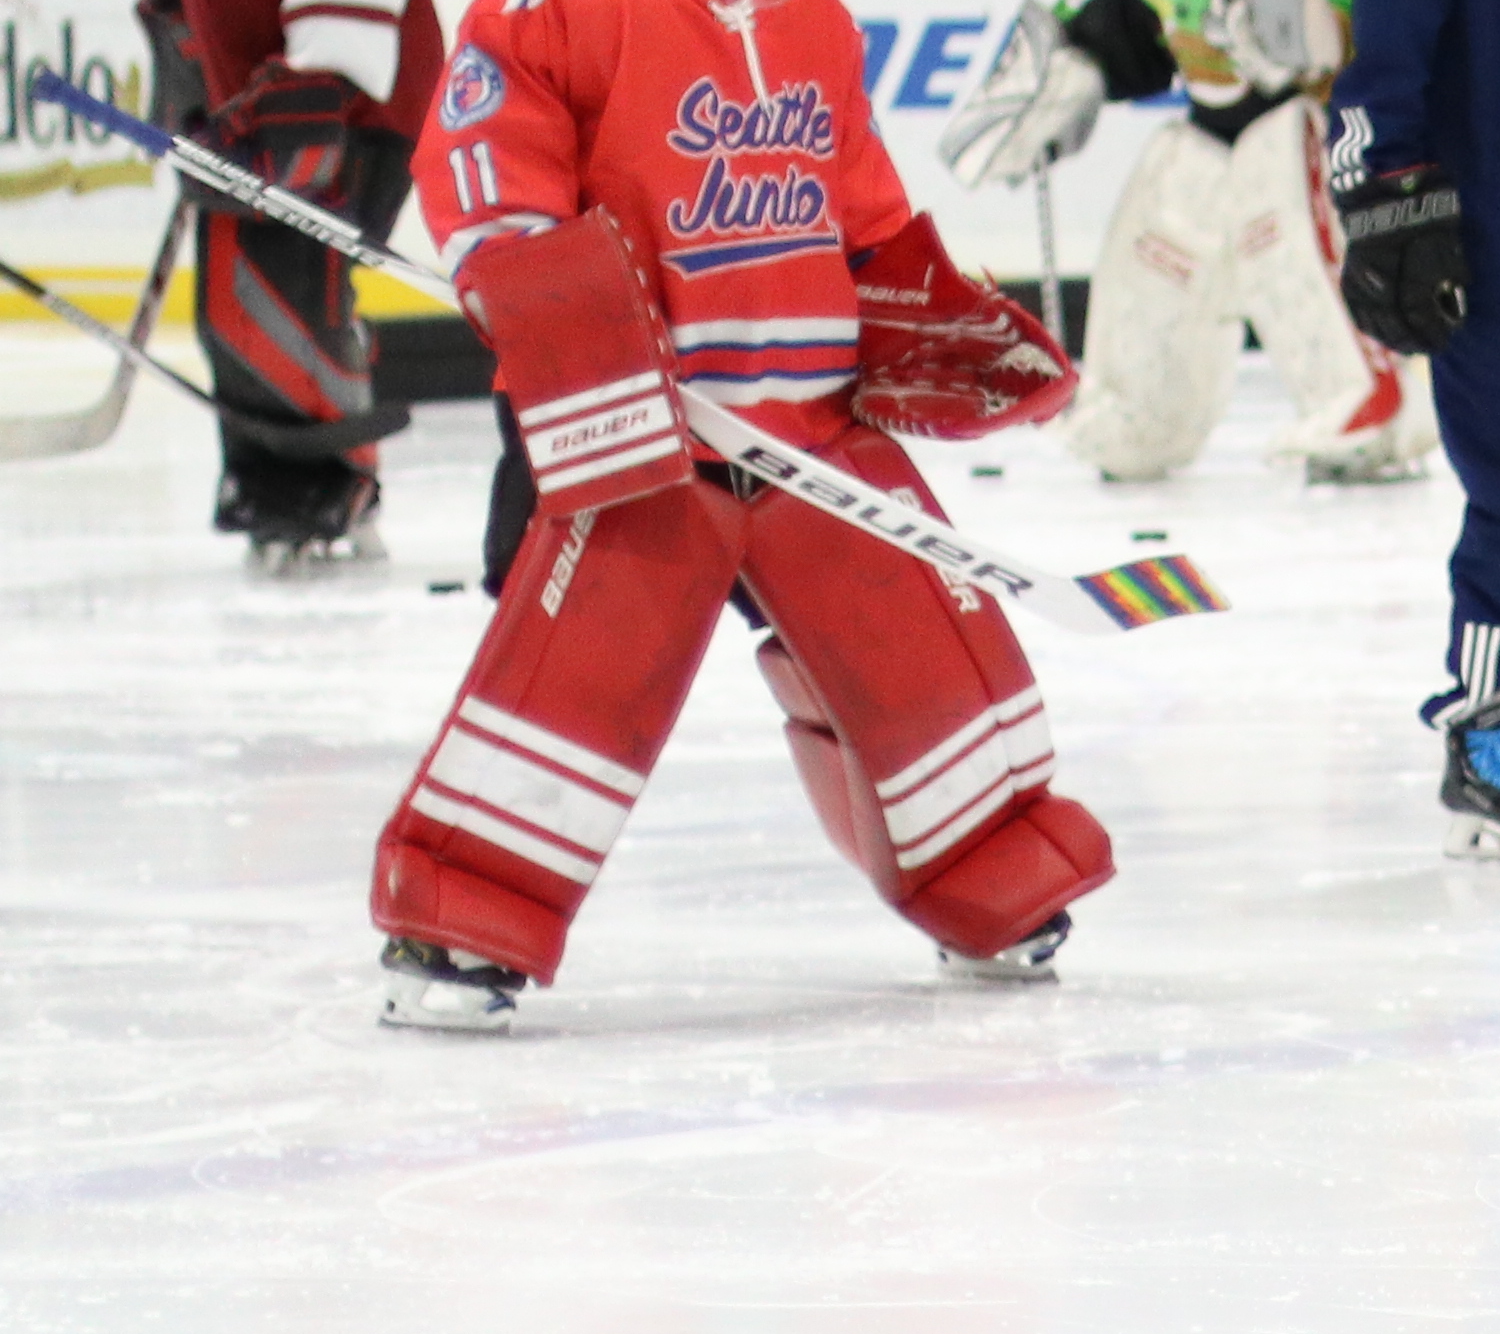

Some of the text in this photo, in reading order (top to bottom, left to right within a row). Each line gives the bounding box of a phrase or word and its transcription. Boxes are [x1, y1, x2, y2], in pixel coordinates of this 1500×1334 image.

[665, 75, 836, 162] Seattle
[449, 142, 499, 214] 11
[551, 408, 649, 453] BAUER
[741, 446, 1035, 599] BAUER
